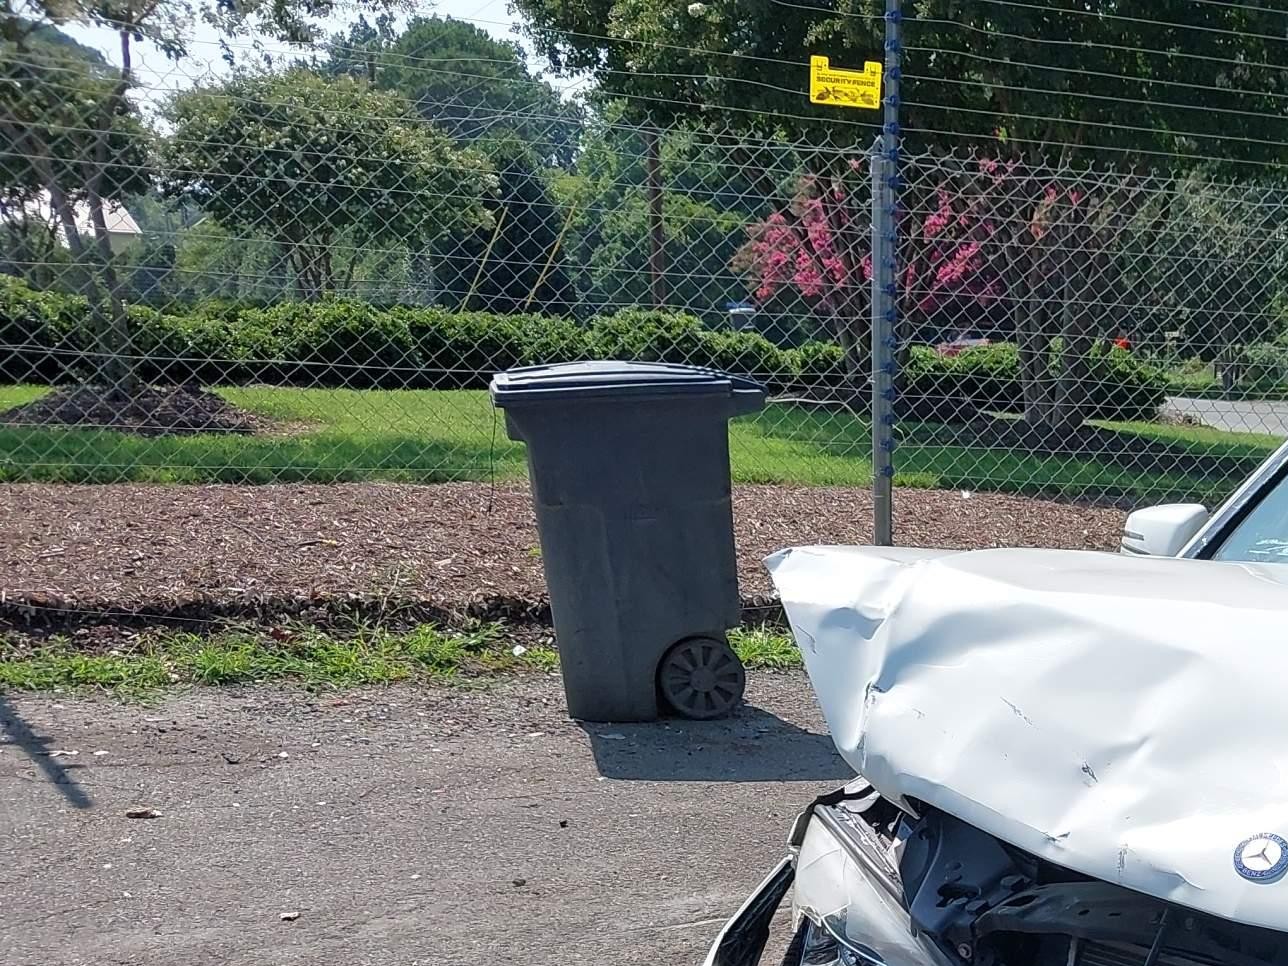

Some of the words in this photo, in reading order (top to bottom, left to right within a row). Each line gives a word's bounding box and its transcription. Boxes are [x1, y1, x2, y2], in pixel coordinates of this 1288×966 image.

[816, 76, 852, 85] SECURITY
[852, 79, 876, 88] FENCE
[1242, 867, 1261, 877] BENZ
